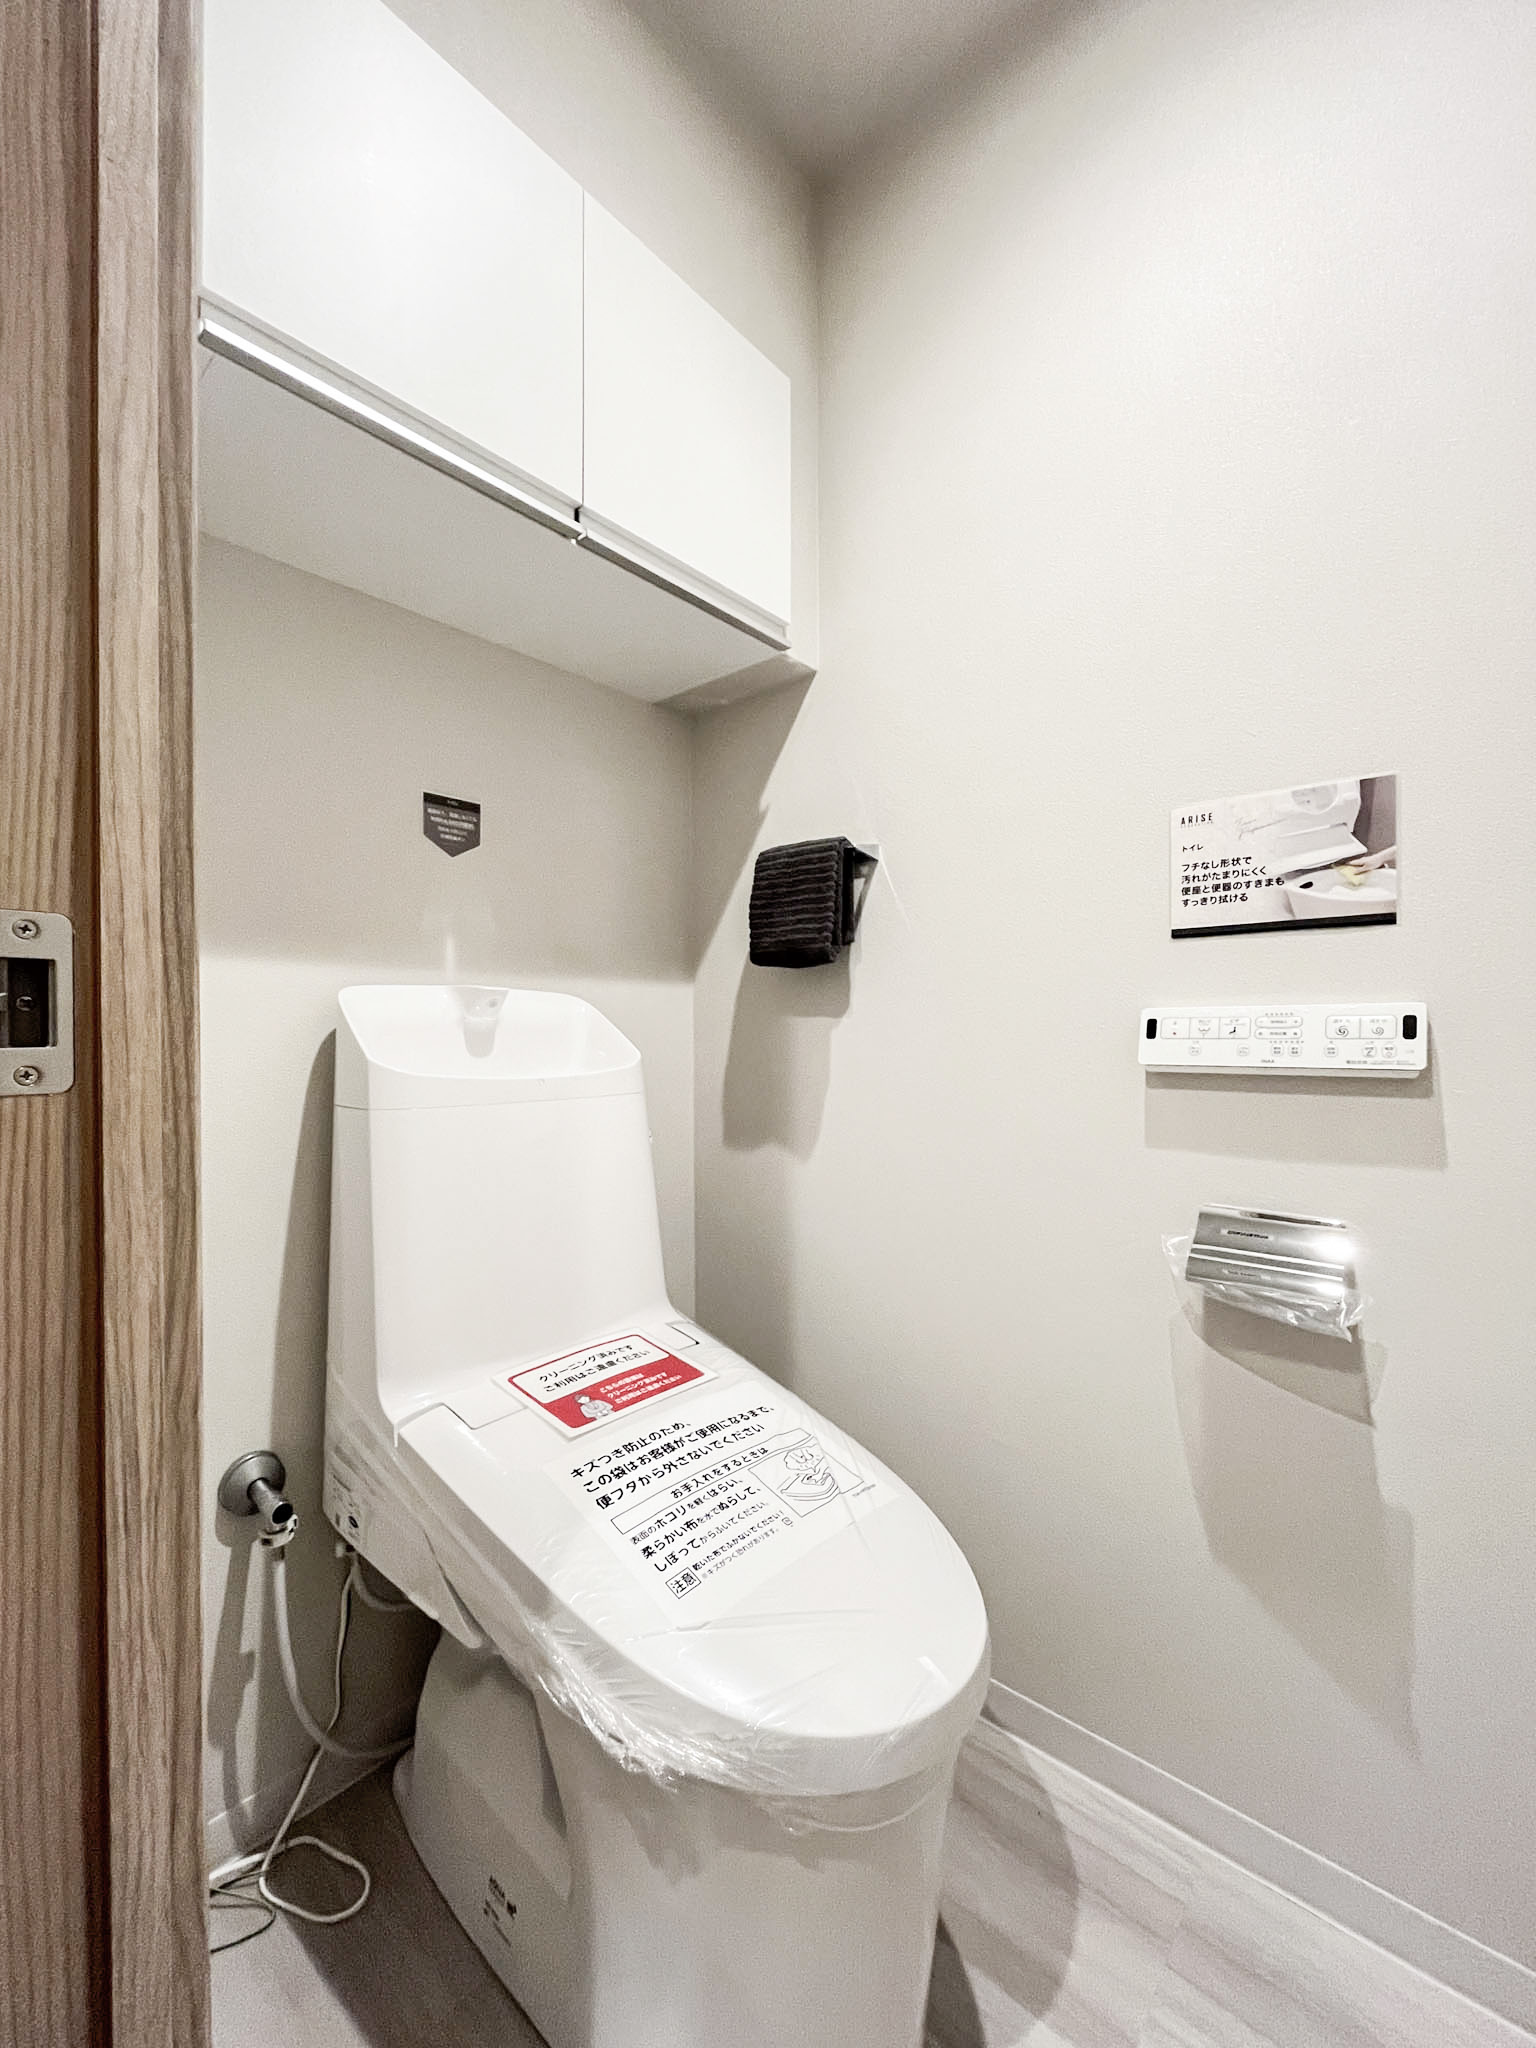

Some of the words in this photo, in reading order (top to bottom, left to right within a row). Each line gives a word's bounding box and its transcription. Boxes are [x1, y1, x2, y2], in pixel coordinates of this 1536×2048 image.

[1181, 812, 1213, 825] ARISE
[1182, 843, 1204, 853] トイレ
[1181, 856, 1252, 873] フチなし形状で
[1181, 865, 1267, 885] 汚れがたまりにくく
[1181, 877, 1285, 896] 便座と便器のすきまも
[1181, 893, 1249, 907] すっきり拭ける
[539, 1344, 633, 1383] クリーニング済みです
[543, 1349, 651, 1393] ご利用はご遠慮ください
[571, 1422, 692, 1480] キズつき防止のため、
[583, 1405, 775, 1494] この袋はお客様がご使用になるまで、
[595, 1424, 764, 1510] 便フタから外さないでください
[670, 1447, 769, 1499] お手入れをするときは
[670, 1570, 698, 1595] 注意
